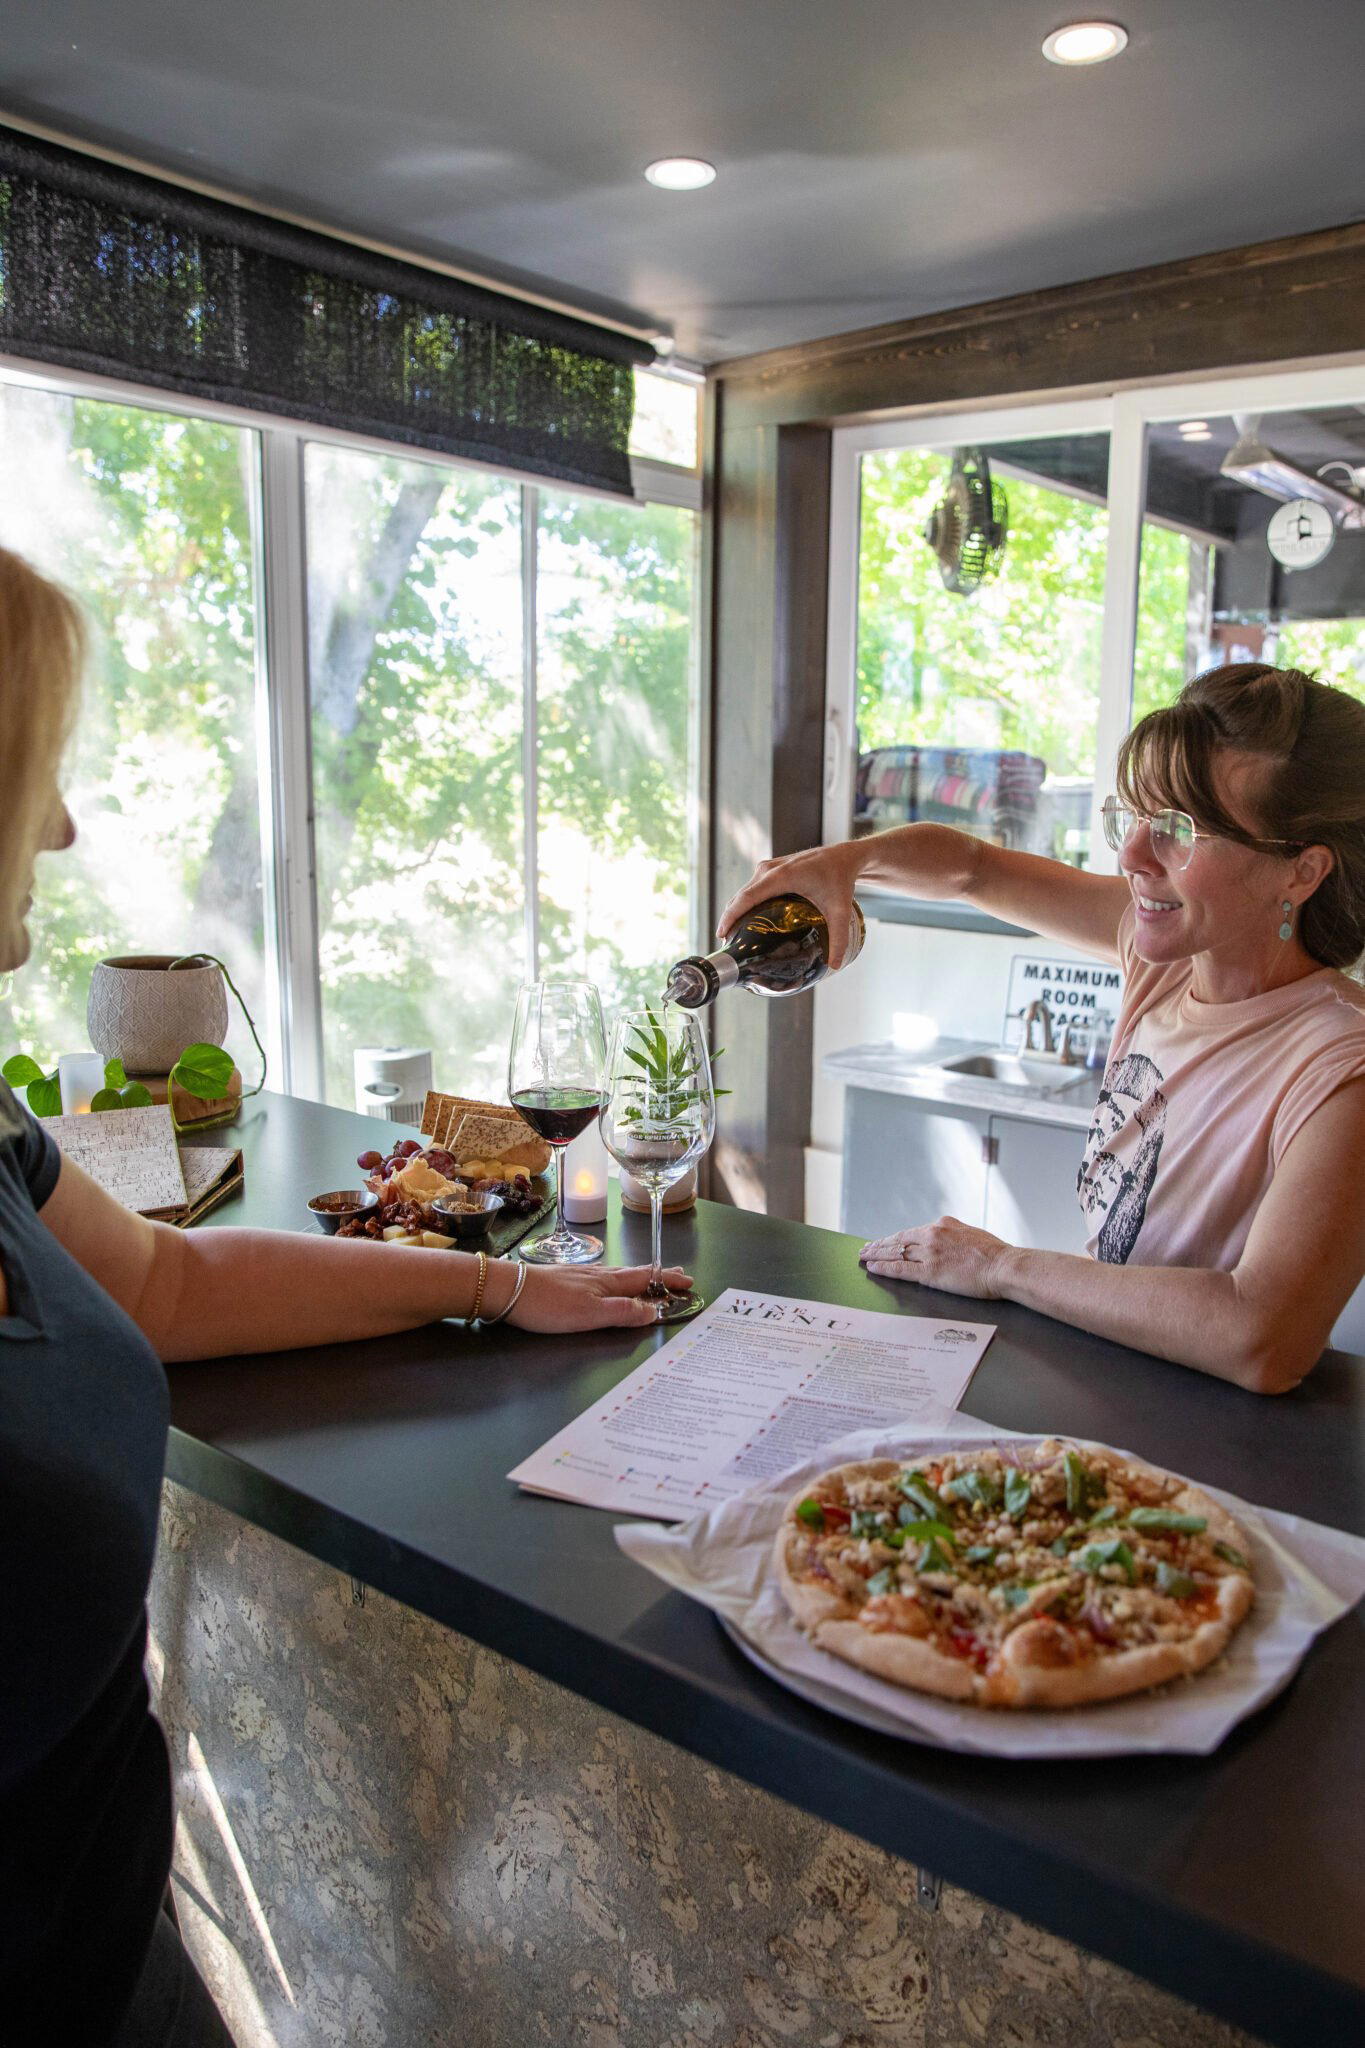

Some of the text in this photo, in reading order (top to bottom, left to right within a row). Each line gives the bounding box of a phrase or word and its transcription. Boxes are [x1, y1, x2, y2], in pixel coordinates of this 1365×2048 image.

[1024, 964, 1120, 988] MAXIMUM
[1042, 988, 1096, 1008] ROOM
[723, 1304, 852, 1330] MENU
[735, 1298, 808, 1315] WINE
